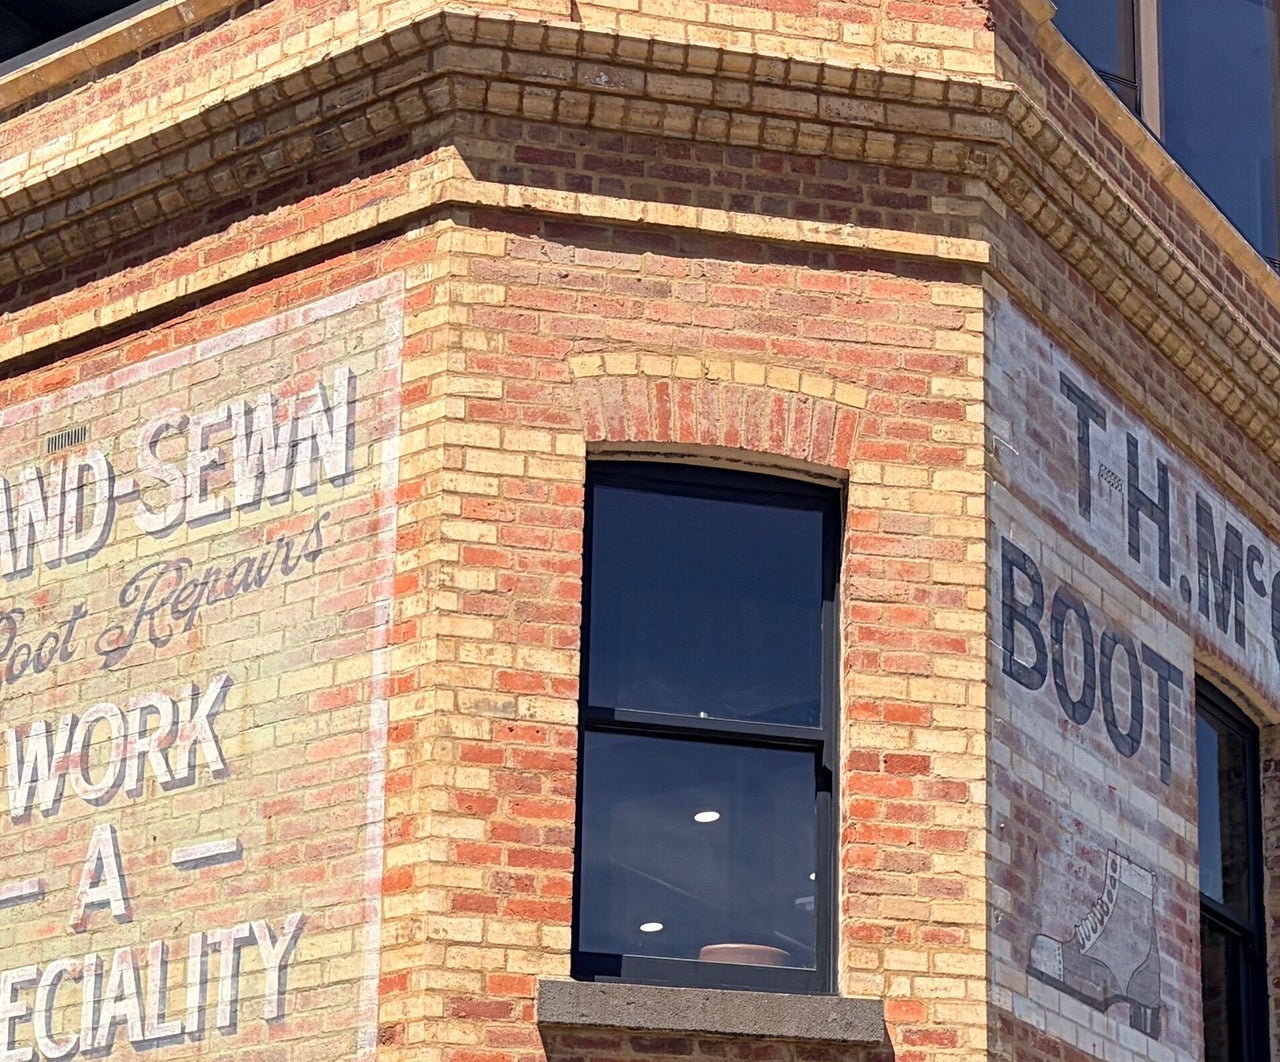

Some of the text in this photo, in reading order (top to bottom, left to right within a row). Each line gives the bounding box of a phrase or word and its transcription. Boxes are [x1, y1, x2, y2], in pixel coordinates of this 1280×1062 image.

[96, 509, 331, 671] Repairs
[1001, 536, 1183, 787] BOOT
[4, 673, 232, 824] WORK
